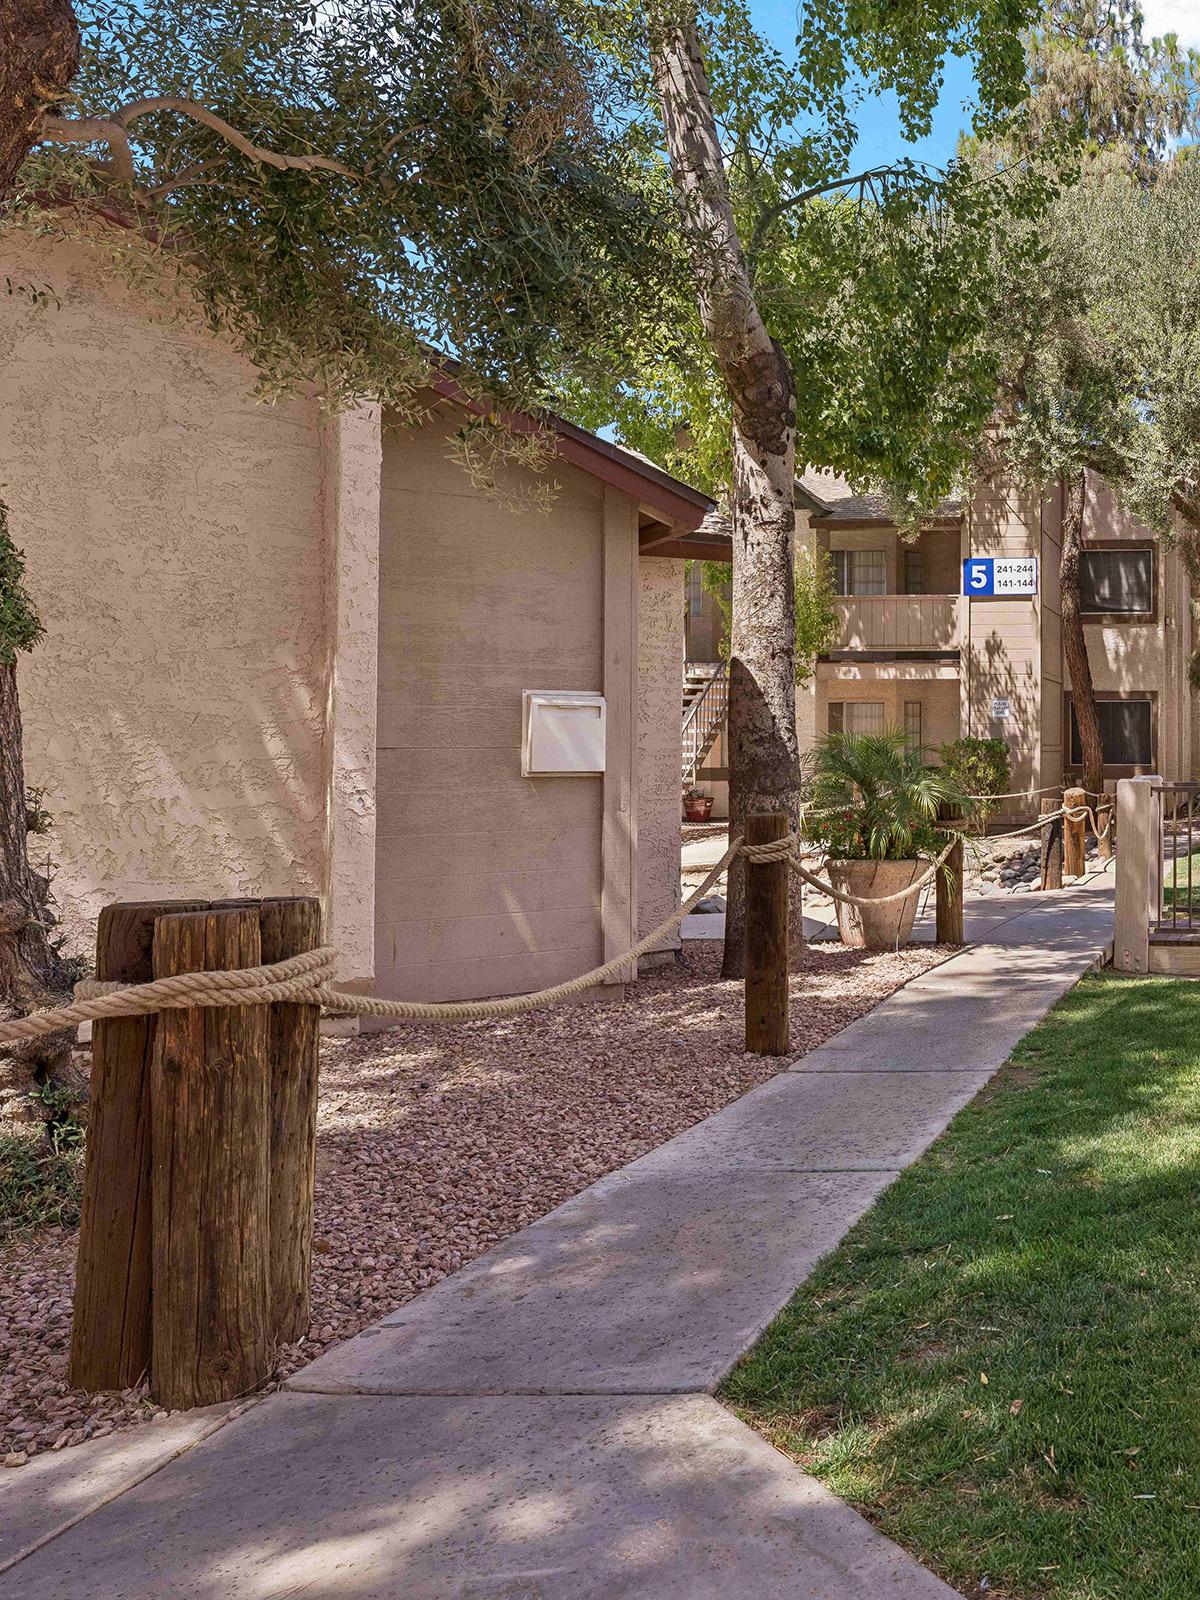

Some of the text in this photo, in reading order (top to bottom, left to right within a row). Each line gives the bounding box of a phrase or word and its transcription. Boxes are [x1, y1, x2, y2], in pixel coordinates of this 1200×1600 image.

[996, 565, 1034, 574] 241-244
[970, 565, 987, 588] 5
[997, 579, 1034, 588] 141-144
